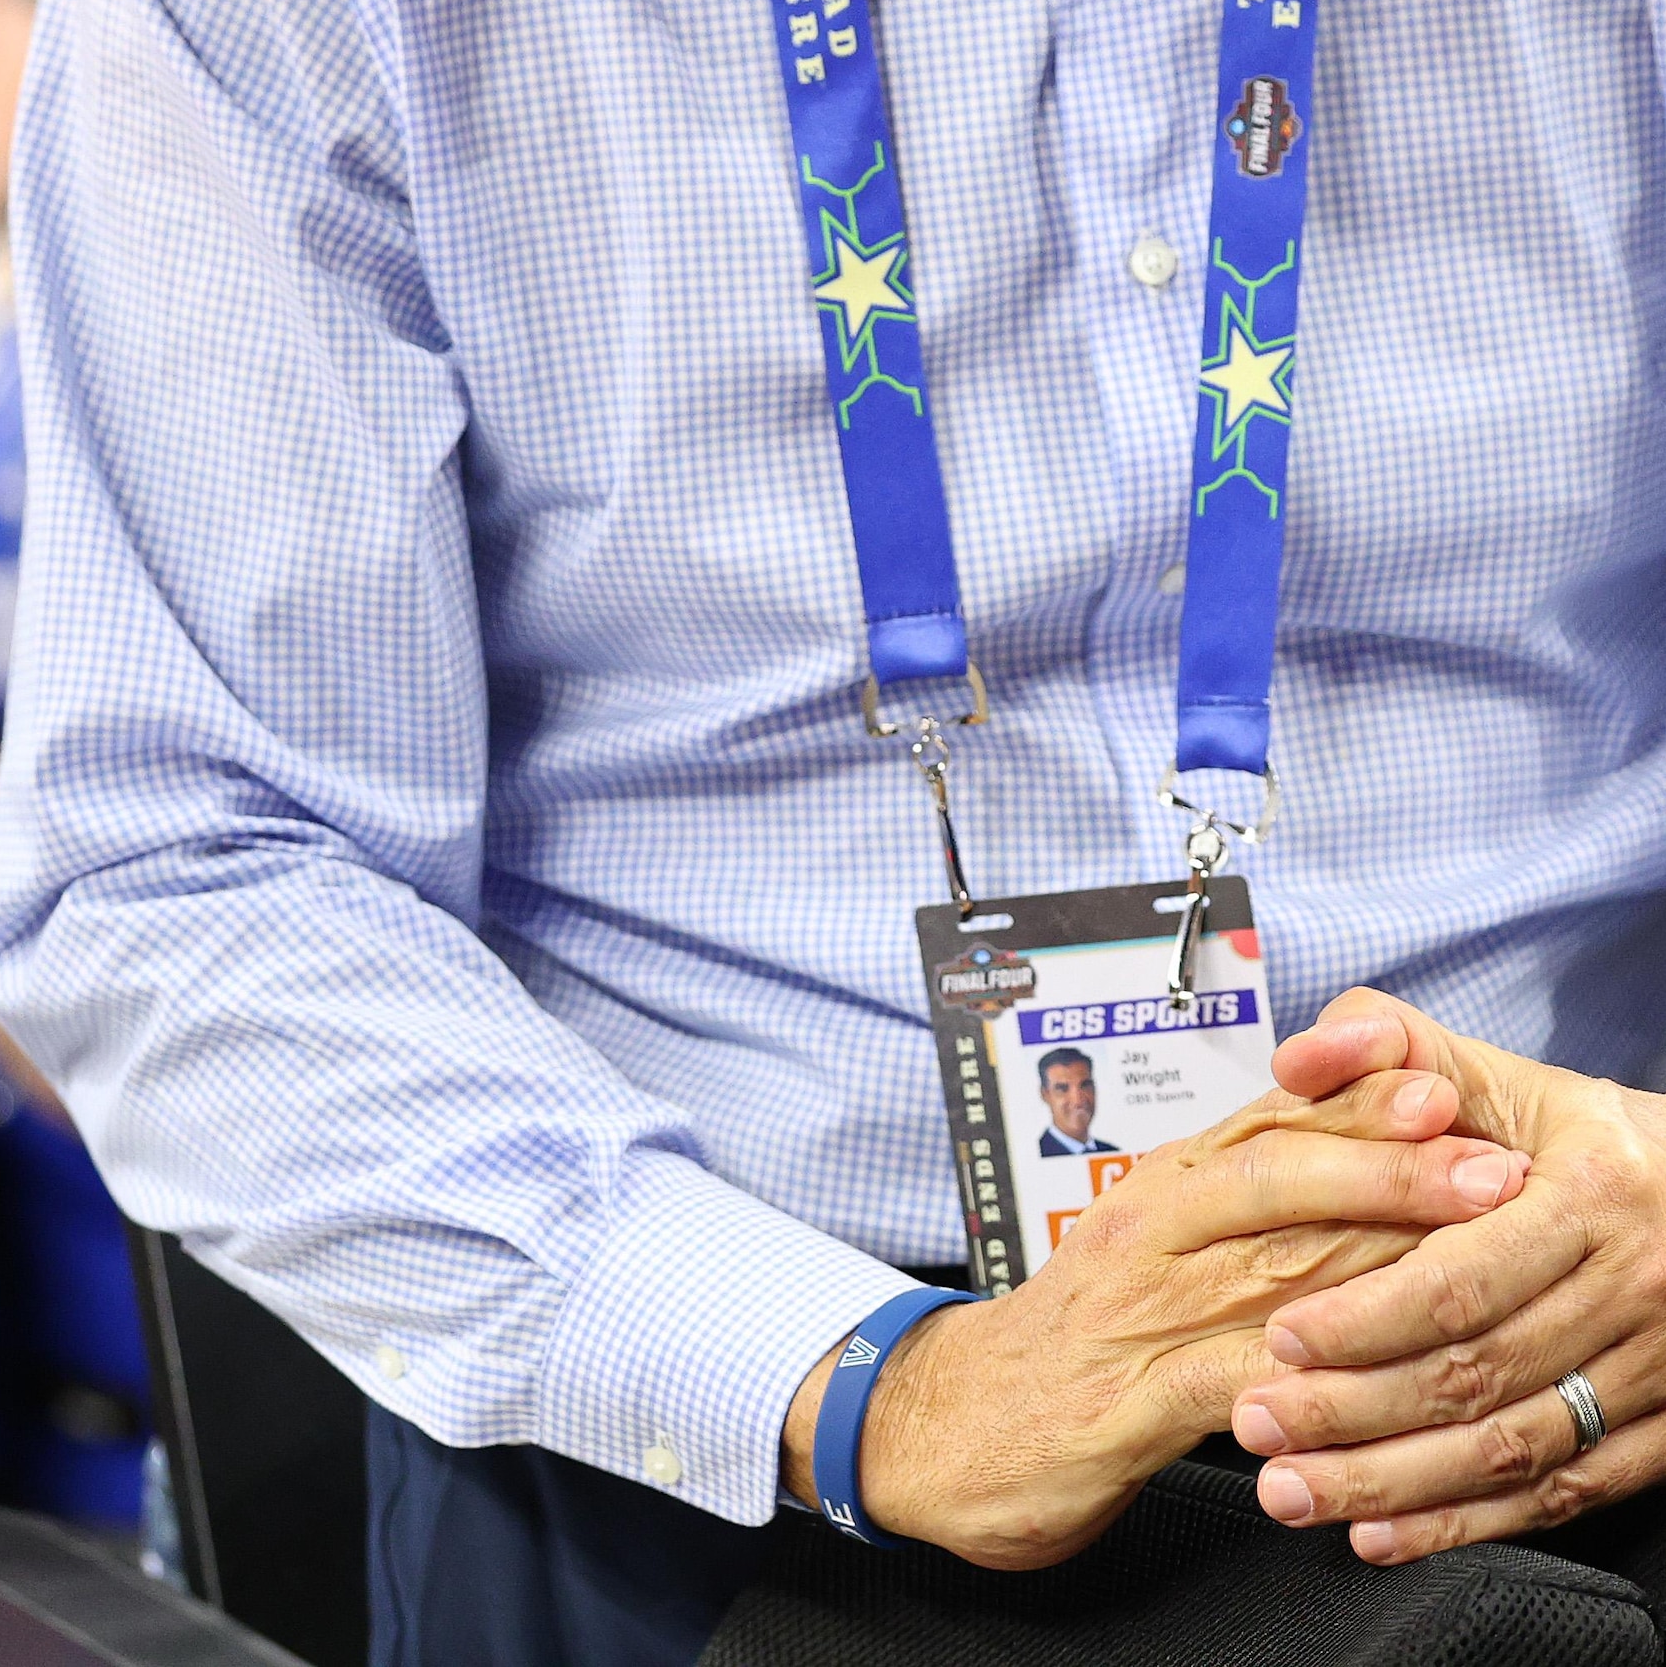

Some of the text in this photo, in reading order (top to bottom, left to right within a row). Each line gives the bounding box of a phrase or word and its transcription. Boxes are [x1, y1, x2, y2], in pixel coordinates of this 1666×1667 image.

[1041, 992, 1240, 1041] CBS SPORTS
[1121, 1050, 1151, 1067] Jay
[1122, 1068, 1183, 1088] Wright
[955, 1035, 1013, 1299] OAD ENDS HERE
